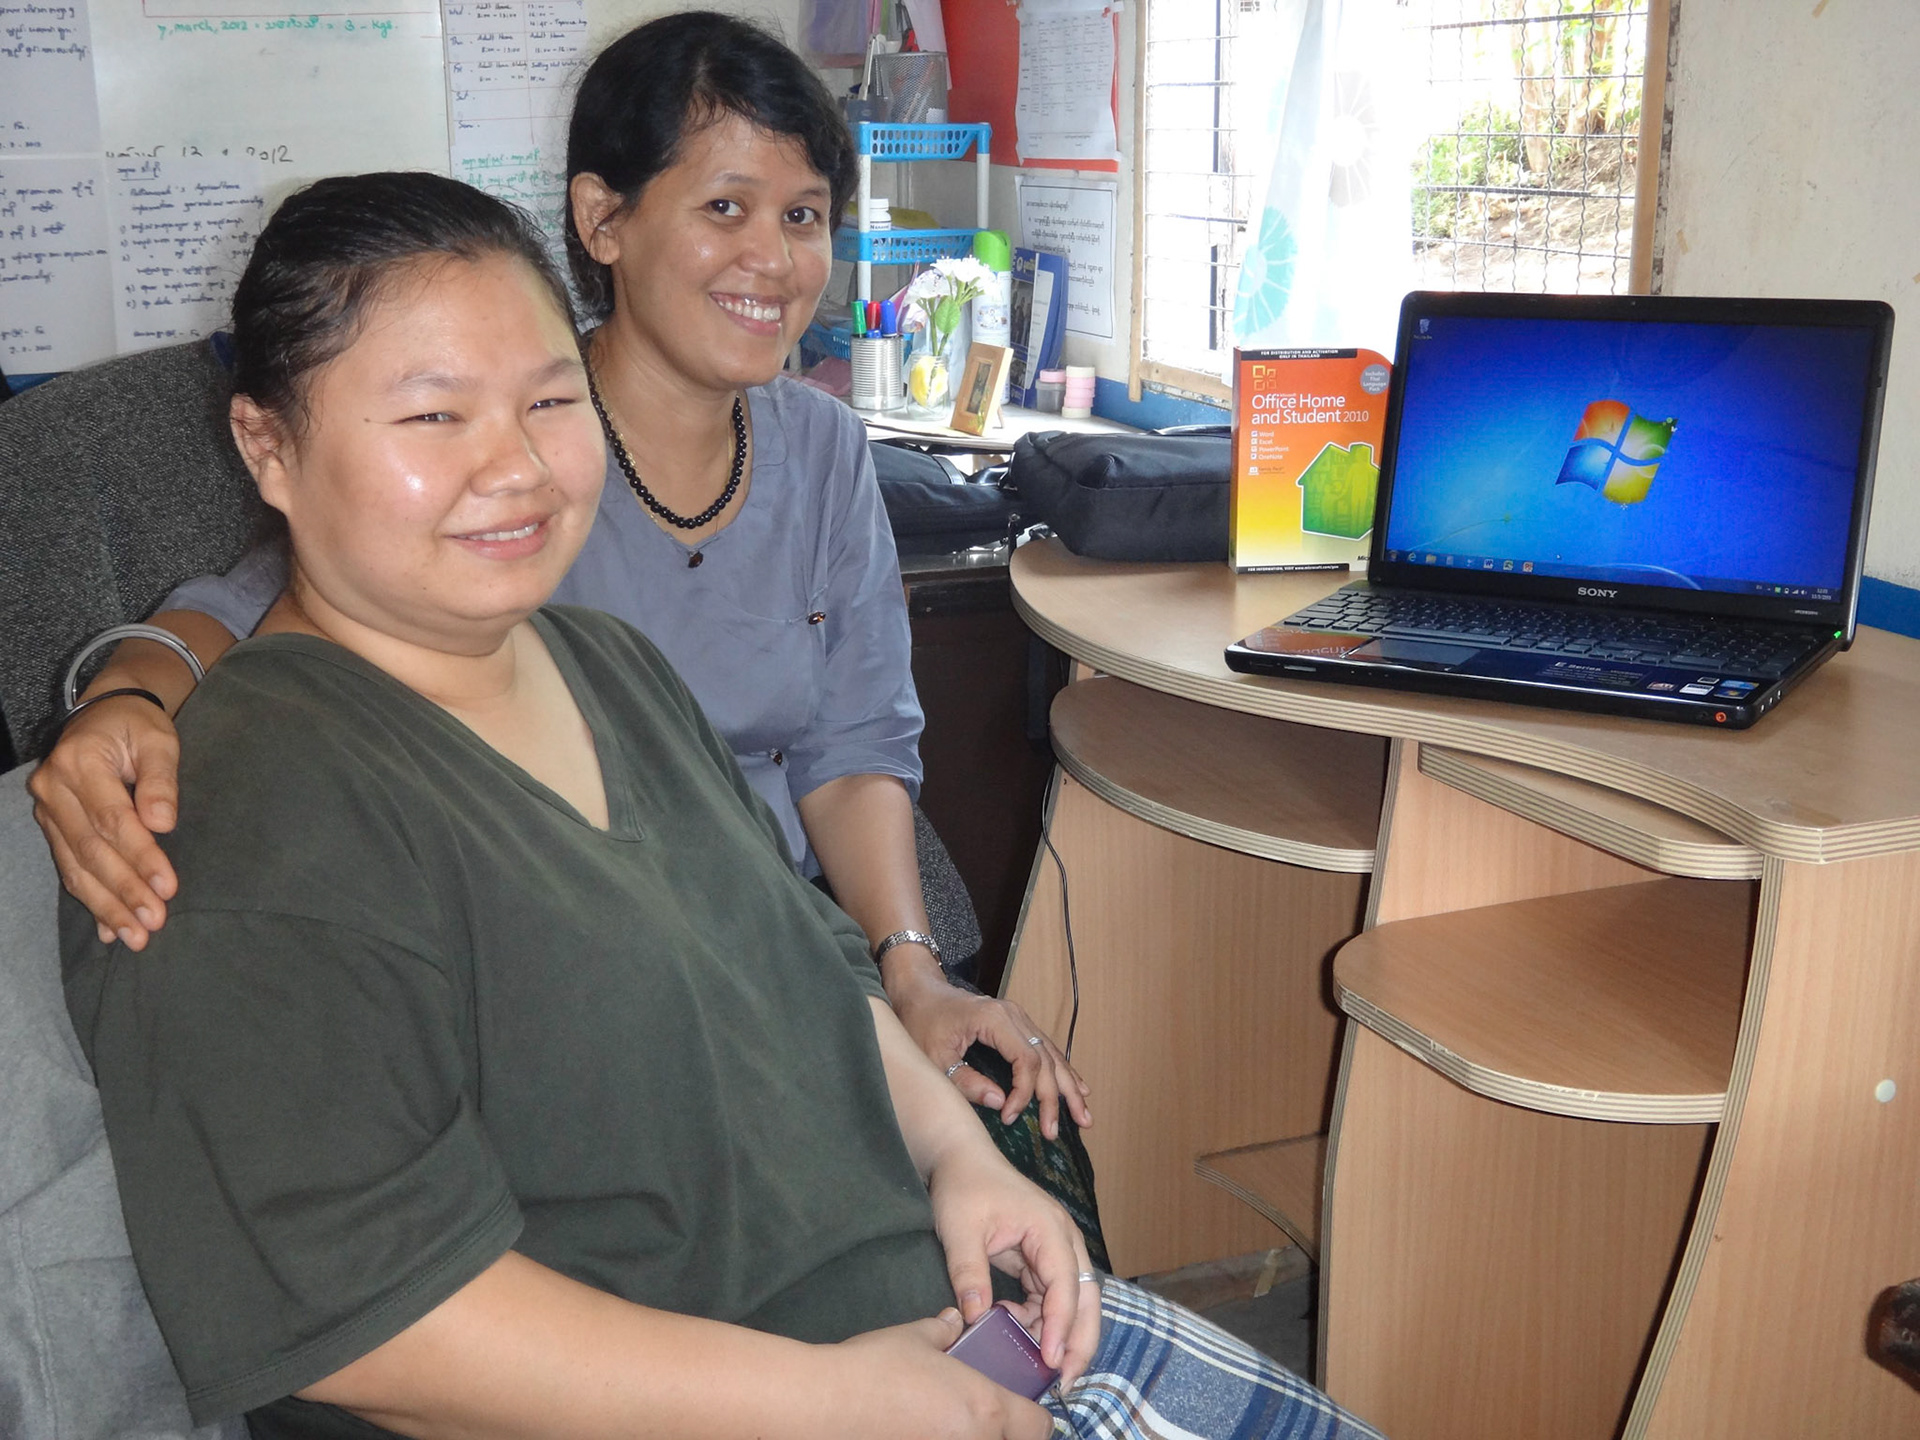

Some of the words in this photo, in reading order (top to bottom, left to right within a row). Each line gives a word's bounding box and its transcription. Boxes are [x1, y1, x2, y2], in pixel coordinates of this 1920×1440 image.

[220, 20, 248, 31] 2012
[1252, 394, 1296, 410] Office
[1300, 394, 1346, 408] Home
[1252, 411, 1280, 424] and
[1282, 410, 1341, 424] Student
[1343, 410, 1369, 422] 2010
[1578, 587, 1618, 598] SONY
